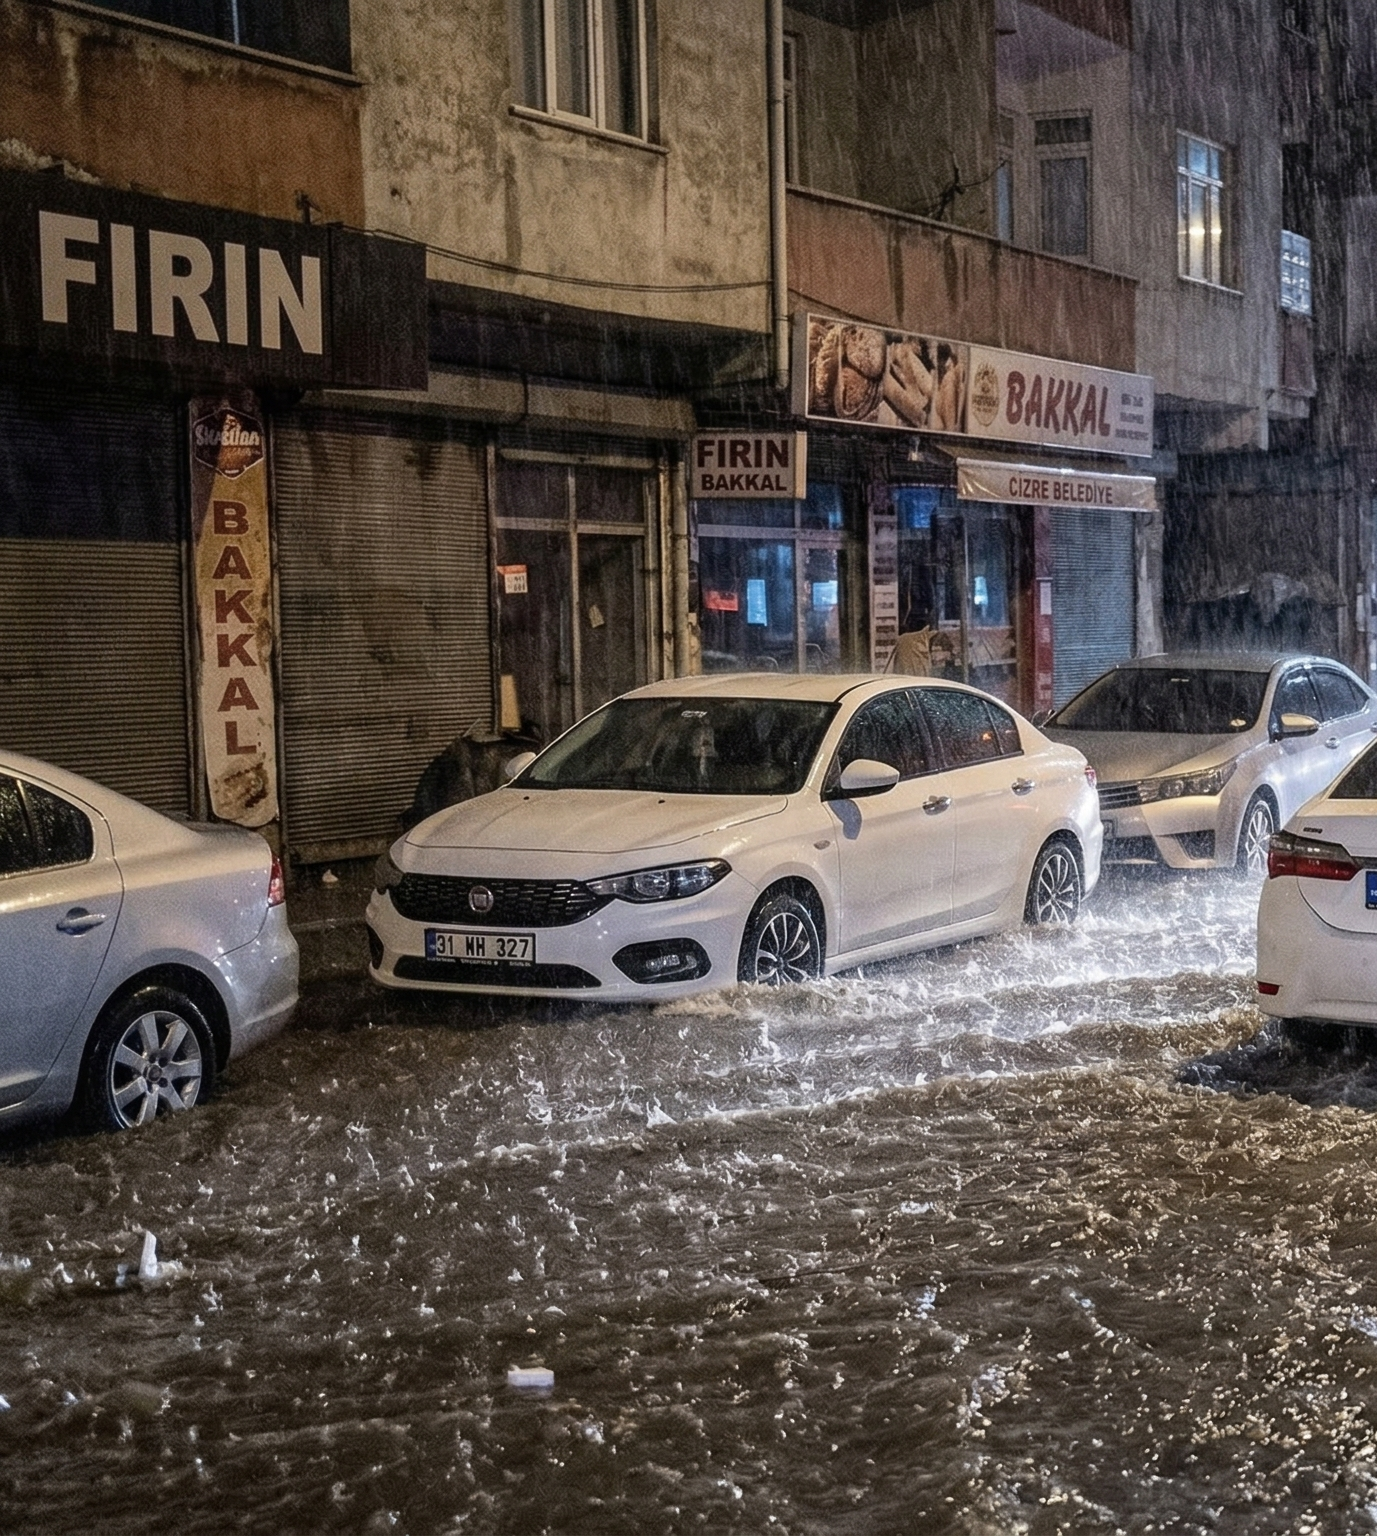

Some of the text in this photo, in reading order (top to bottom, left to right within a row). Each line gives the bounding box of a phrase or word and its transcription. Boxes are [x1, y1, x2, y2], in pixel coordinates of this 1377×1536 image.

[39, 210, 323, 355] FIRIN
[1005, 370, 1111, 437] BAKKAL
[697, 439, 789, 469] FIRIN
[701, 474, 787, 491] BAKKAL
[212, 500, 259, 756] BAKKAL
[437, 934, 454, 955] 31
[496, 938, 529, 958] 327
